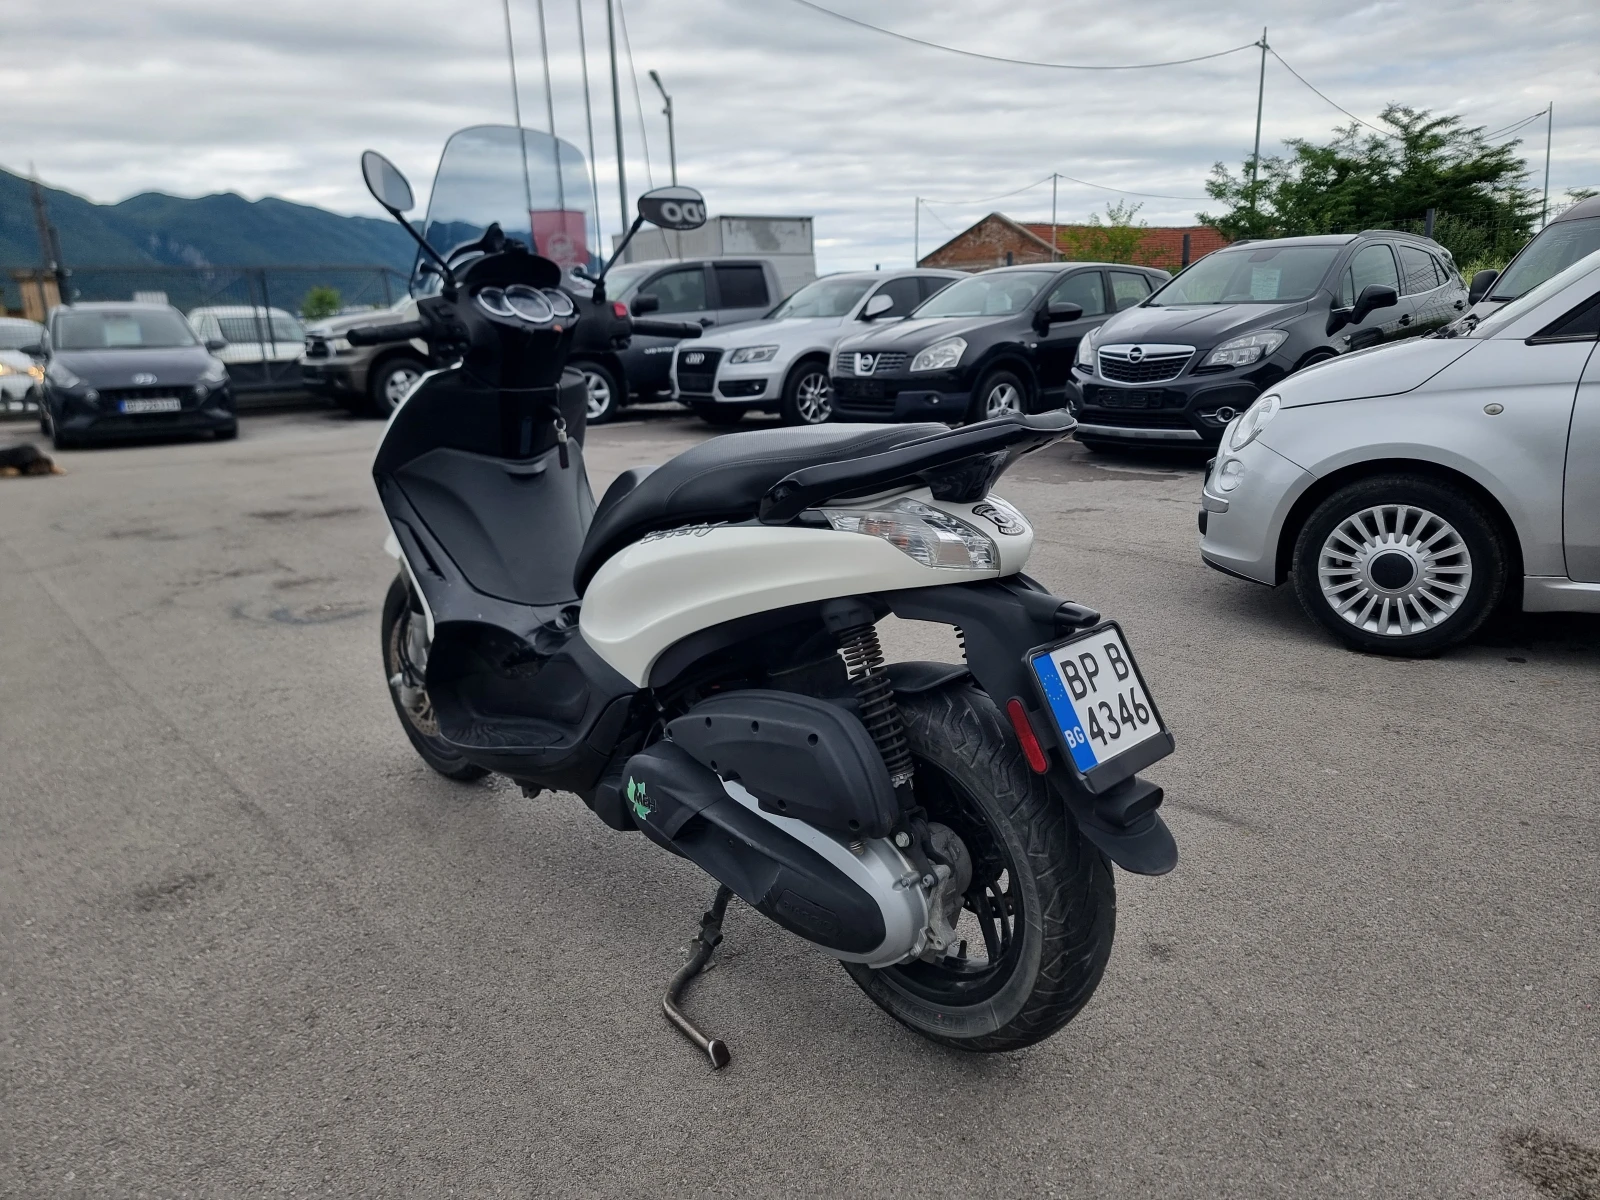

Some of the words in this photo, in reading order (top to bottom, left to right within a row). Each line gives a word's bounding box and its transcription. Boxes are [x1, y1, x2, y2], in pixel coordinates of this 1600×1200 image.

[1060, 652, 1099, 701] BP
[1103, 643, 1129, 681] B
[1064, 725, 1086, 749] BG
[1088, 686, 1150, 746] 4346
